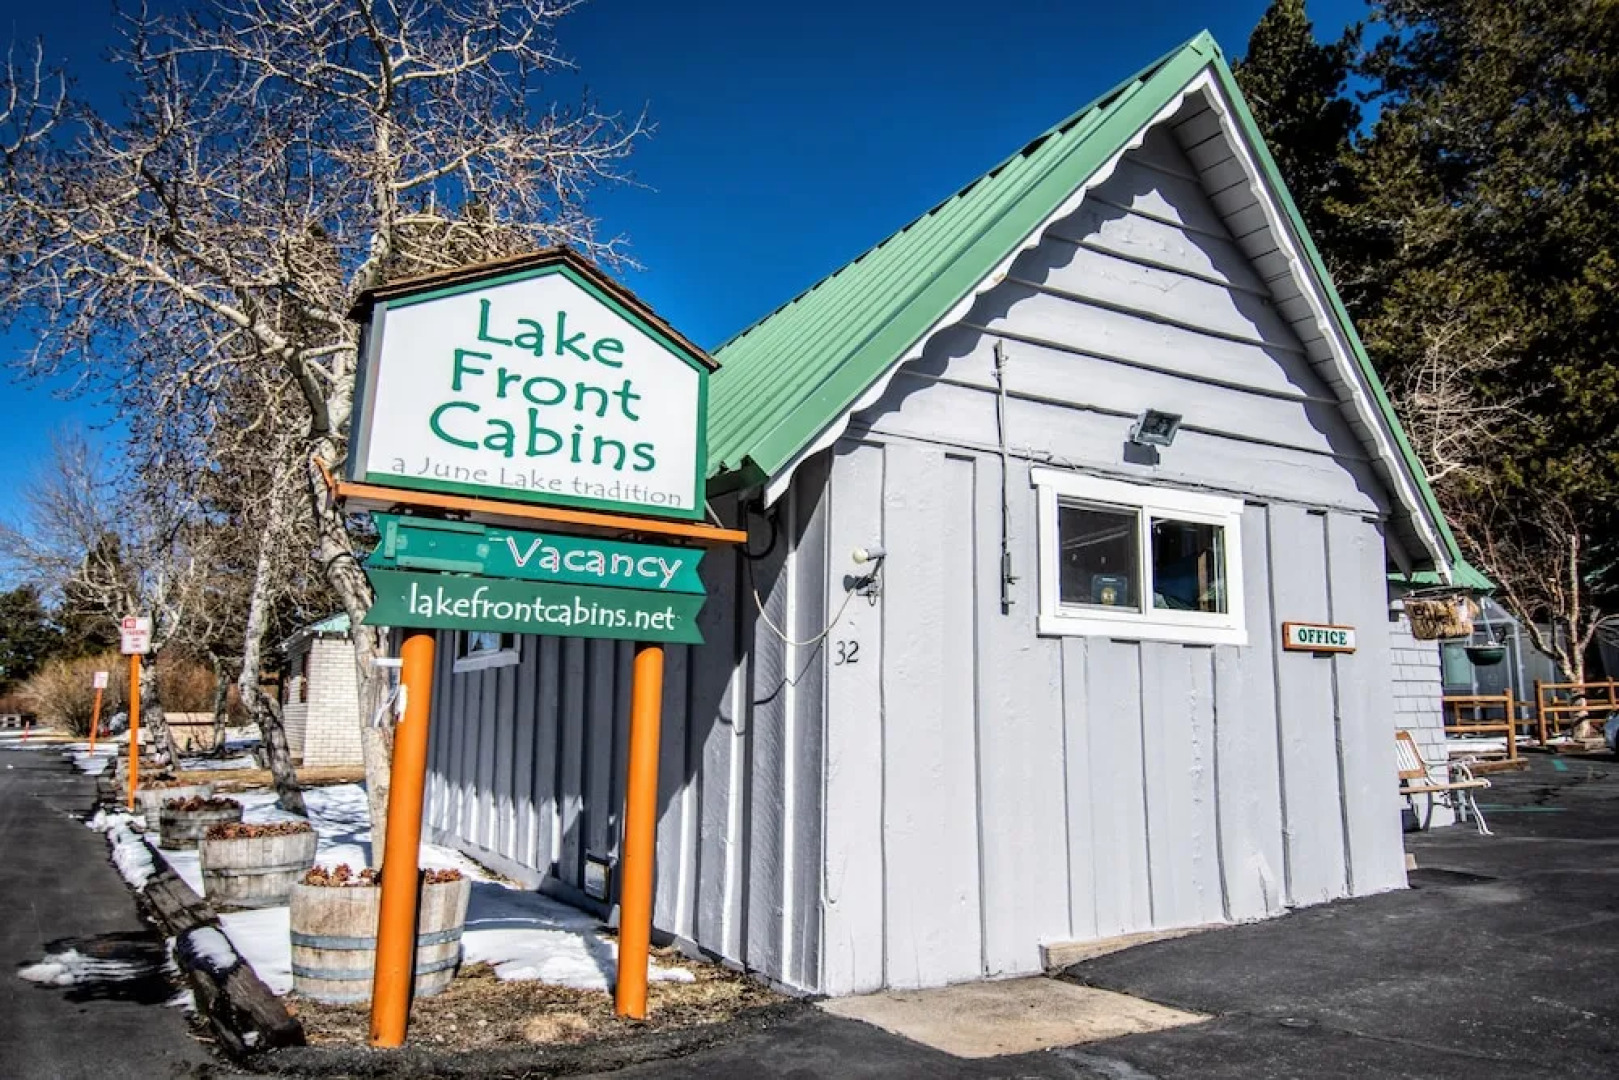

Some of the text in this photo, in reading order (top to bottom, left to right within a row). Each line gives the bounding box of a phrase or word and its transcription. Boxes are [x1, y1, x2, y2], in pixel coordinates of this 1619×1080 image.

[477, 298, 624, 368] Lake
[451, 348, 641, 421] Front
[428, 401, 656, 472] Cabins
[391, 457, 683, 507] a June Lake tradition
[506, 536, 682, 588] Vacancy
[409, 582, 675, 630] lakefrontcabins.net
[834, 640, 859, 666] 32
[1298, 628, 1347, 645] OFFICE
